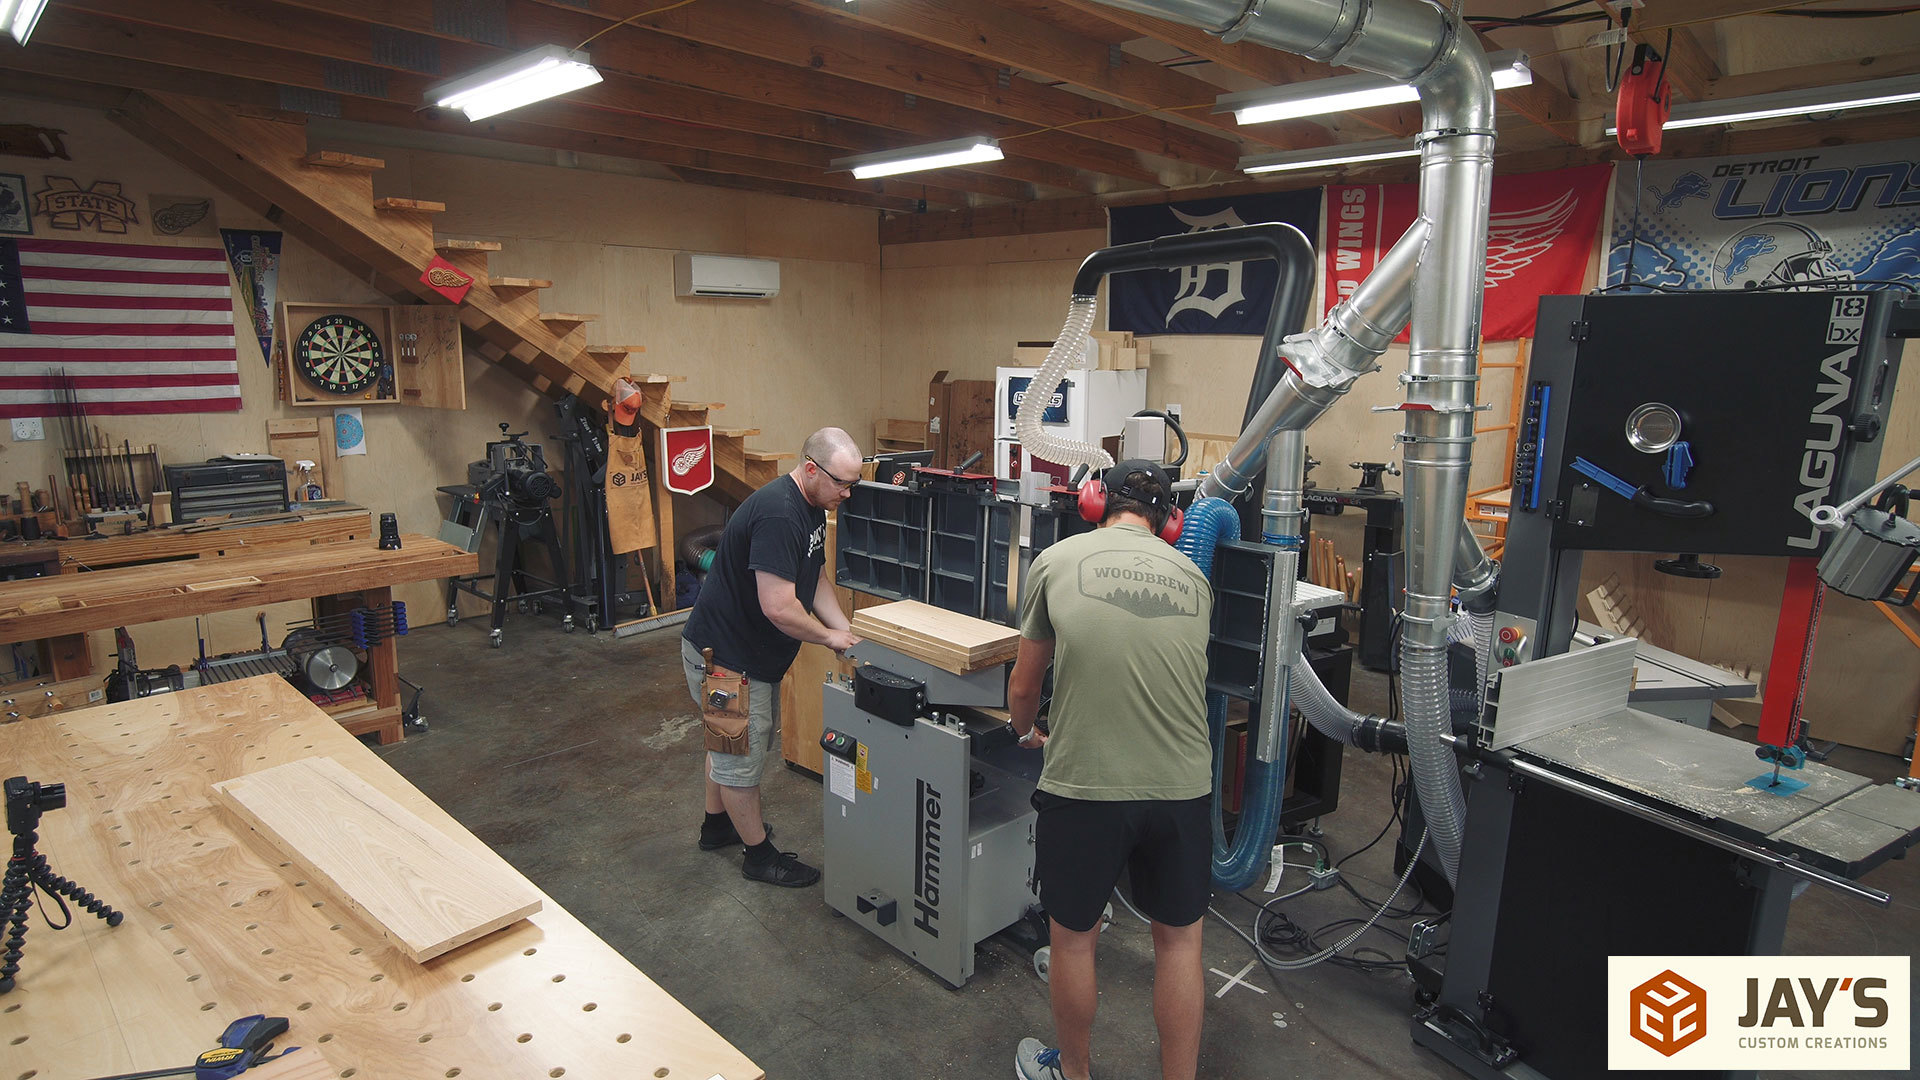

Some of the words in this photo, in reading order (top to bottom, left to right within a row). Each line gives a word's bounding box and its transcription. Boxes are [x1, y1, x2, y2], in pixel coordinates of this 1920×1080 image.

[1712, 156, 1820, 178] DETROIT
[54, 195, 119, 214] STATE
[1336, 188, 1366, 271] WINGS
[1835, 298, 1865, 317] 18
[1827, 322, 1860, 342] bx
[1787, 345, 1859, 550] LAGUNA
[1302, 494, 1338, 503] LAGUNA
[1094, 567, 1189, 595] WOODBREW
[914, 782, 942, 939] Hammer
